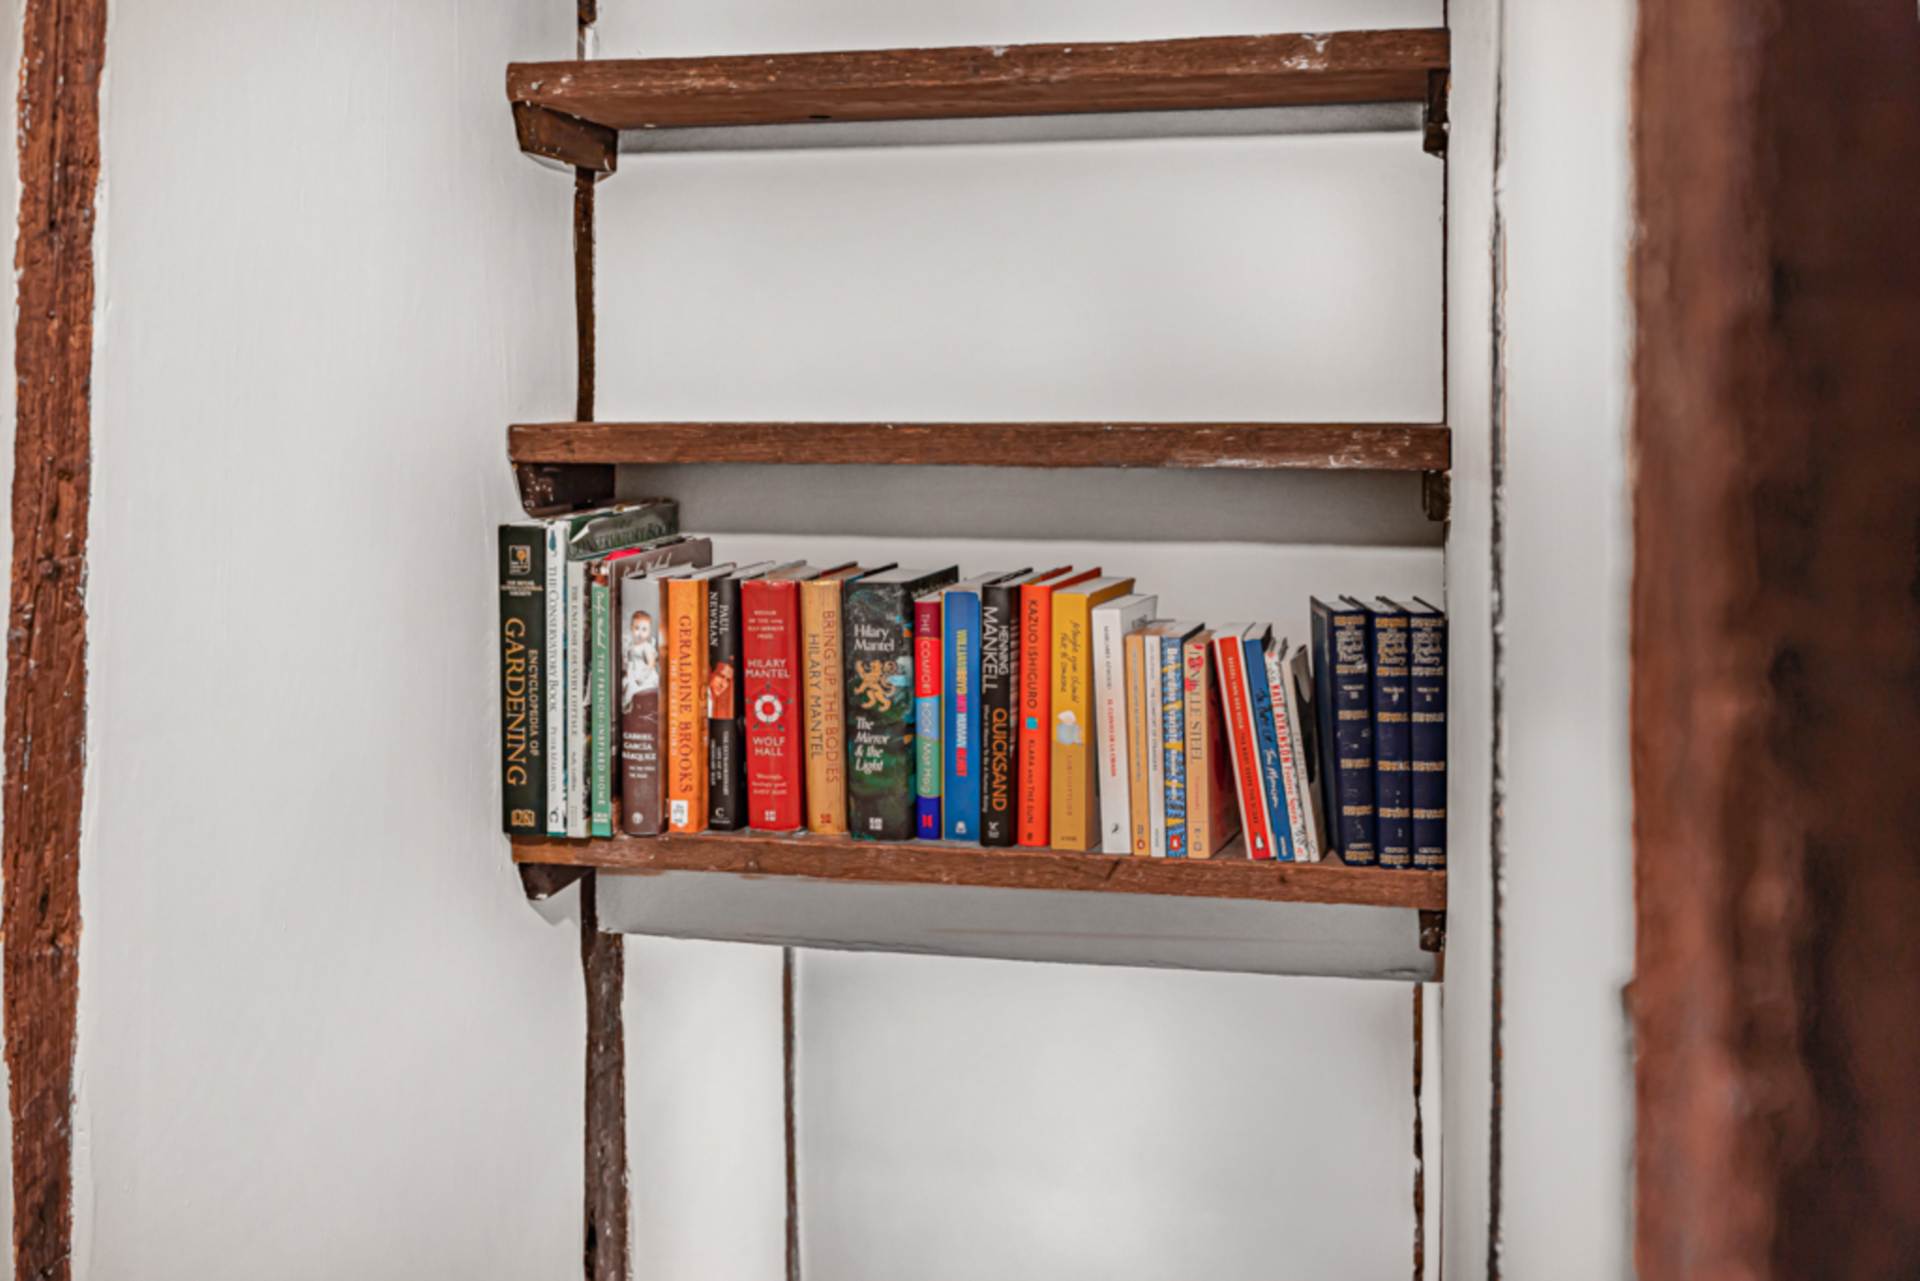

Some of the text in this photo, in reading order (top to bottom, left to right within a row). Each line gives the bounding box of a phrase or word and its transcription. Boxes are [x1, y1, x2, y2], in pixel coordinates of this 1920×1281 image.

[709, 590, 719, 647] NEWMAN
[719, 604, 729, 635] PAUL
[853, 624, 891, 642] Hilary
[548, 566, 560, 712] THE CONSERVATORY BOOK
[853, 638, 896, 653] Mantel
[982, 606, 999, 694] MANKELL
[998, 625, 1009, 676] HENNING
[1027, 600, 1038, 709] KAZUO ISHIGURO
[597, 654, 605, 673] THE
[679, 615, 692, 713] GERALDINE
[745, 668, 790, 679] MANTEL
[747, 658, 786, 669] HILARY
[920, 614, 932, 733] THE COMFORT BOOK
[505, 617, 528, 786] GARDENING
[528, 649, 540, 756] ENCYCLOPEDIA OF
[808, 633, 824, 760] HILARY MANTEL
[822, 610, 840, 785] BRING UP THE BODIES
[1270, 684, 1288, 708] KATE
[597, 678, 606, 772] FRENCH-INSPIRED
[854, 731, 891, 745] Mirror
[855, 716, 875, 731] The
[1275, 712, 1292, 763] ATKINSON
[679, 721, 693, 793] BROOKS
[752, 736, 785, 747] WOLF
[754, 747, 784, 757] HALL
[854, 744, 884, 758] & the
[1027, 739, 1035, 767] KLARA
[1189, 721, 1203, 765] STEEL
[855, 757, 884, 775] Light
[992, 707, 1008, 811] QUICKSAND
[597, 775, 606, 805] HOME
[1026, 786, 1035, 802] THE
[1026, 805, 1035, 824] SUN
